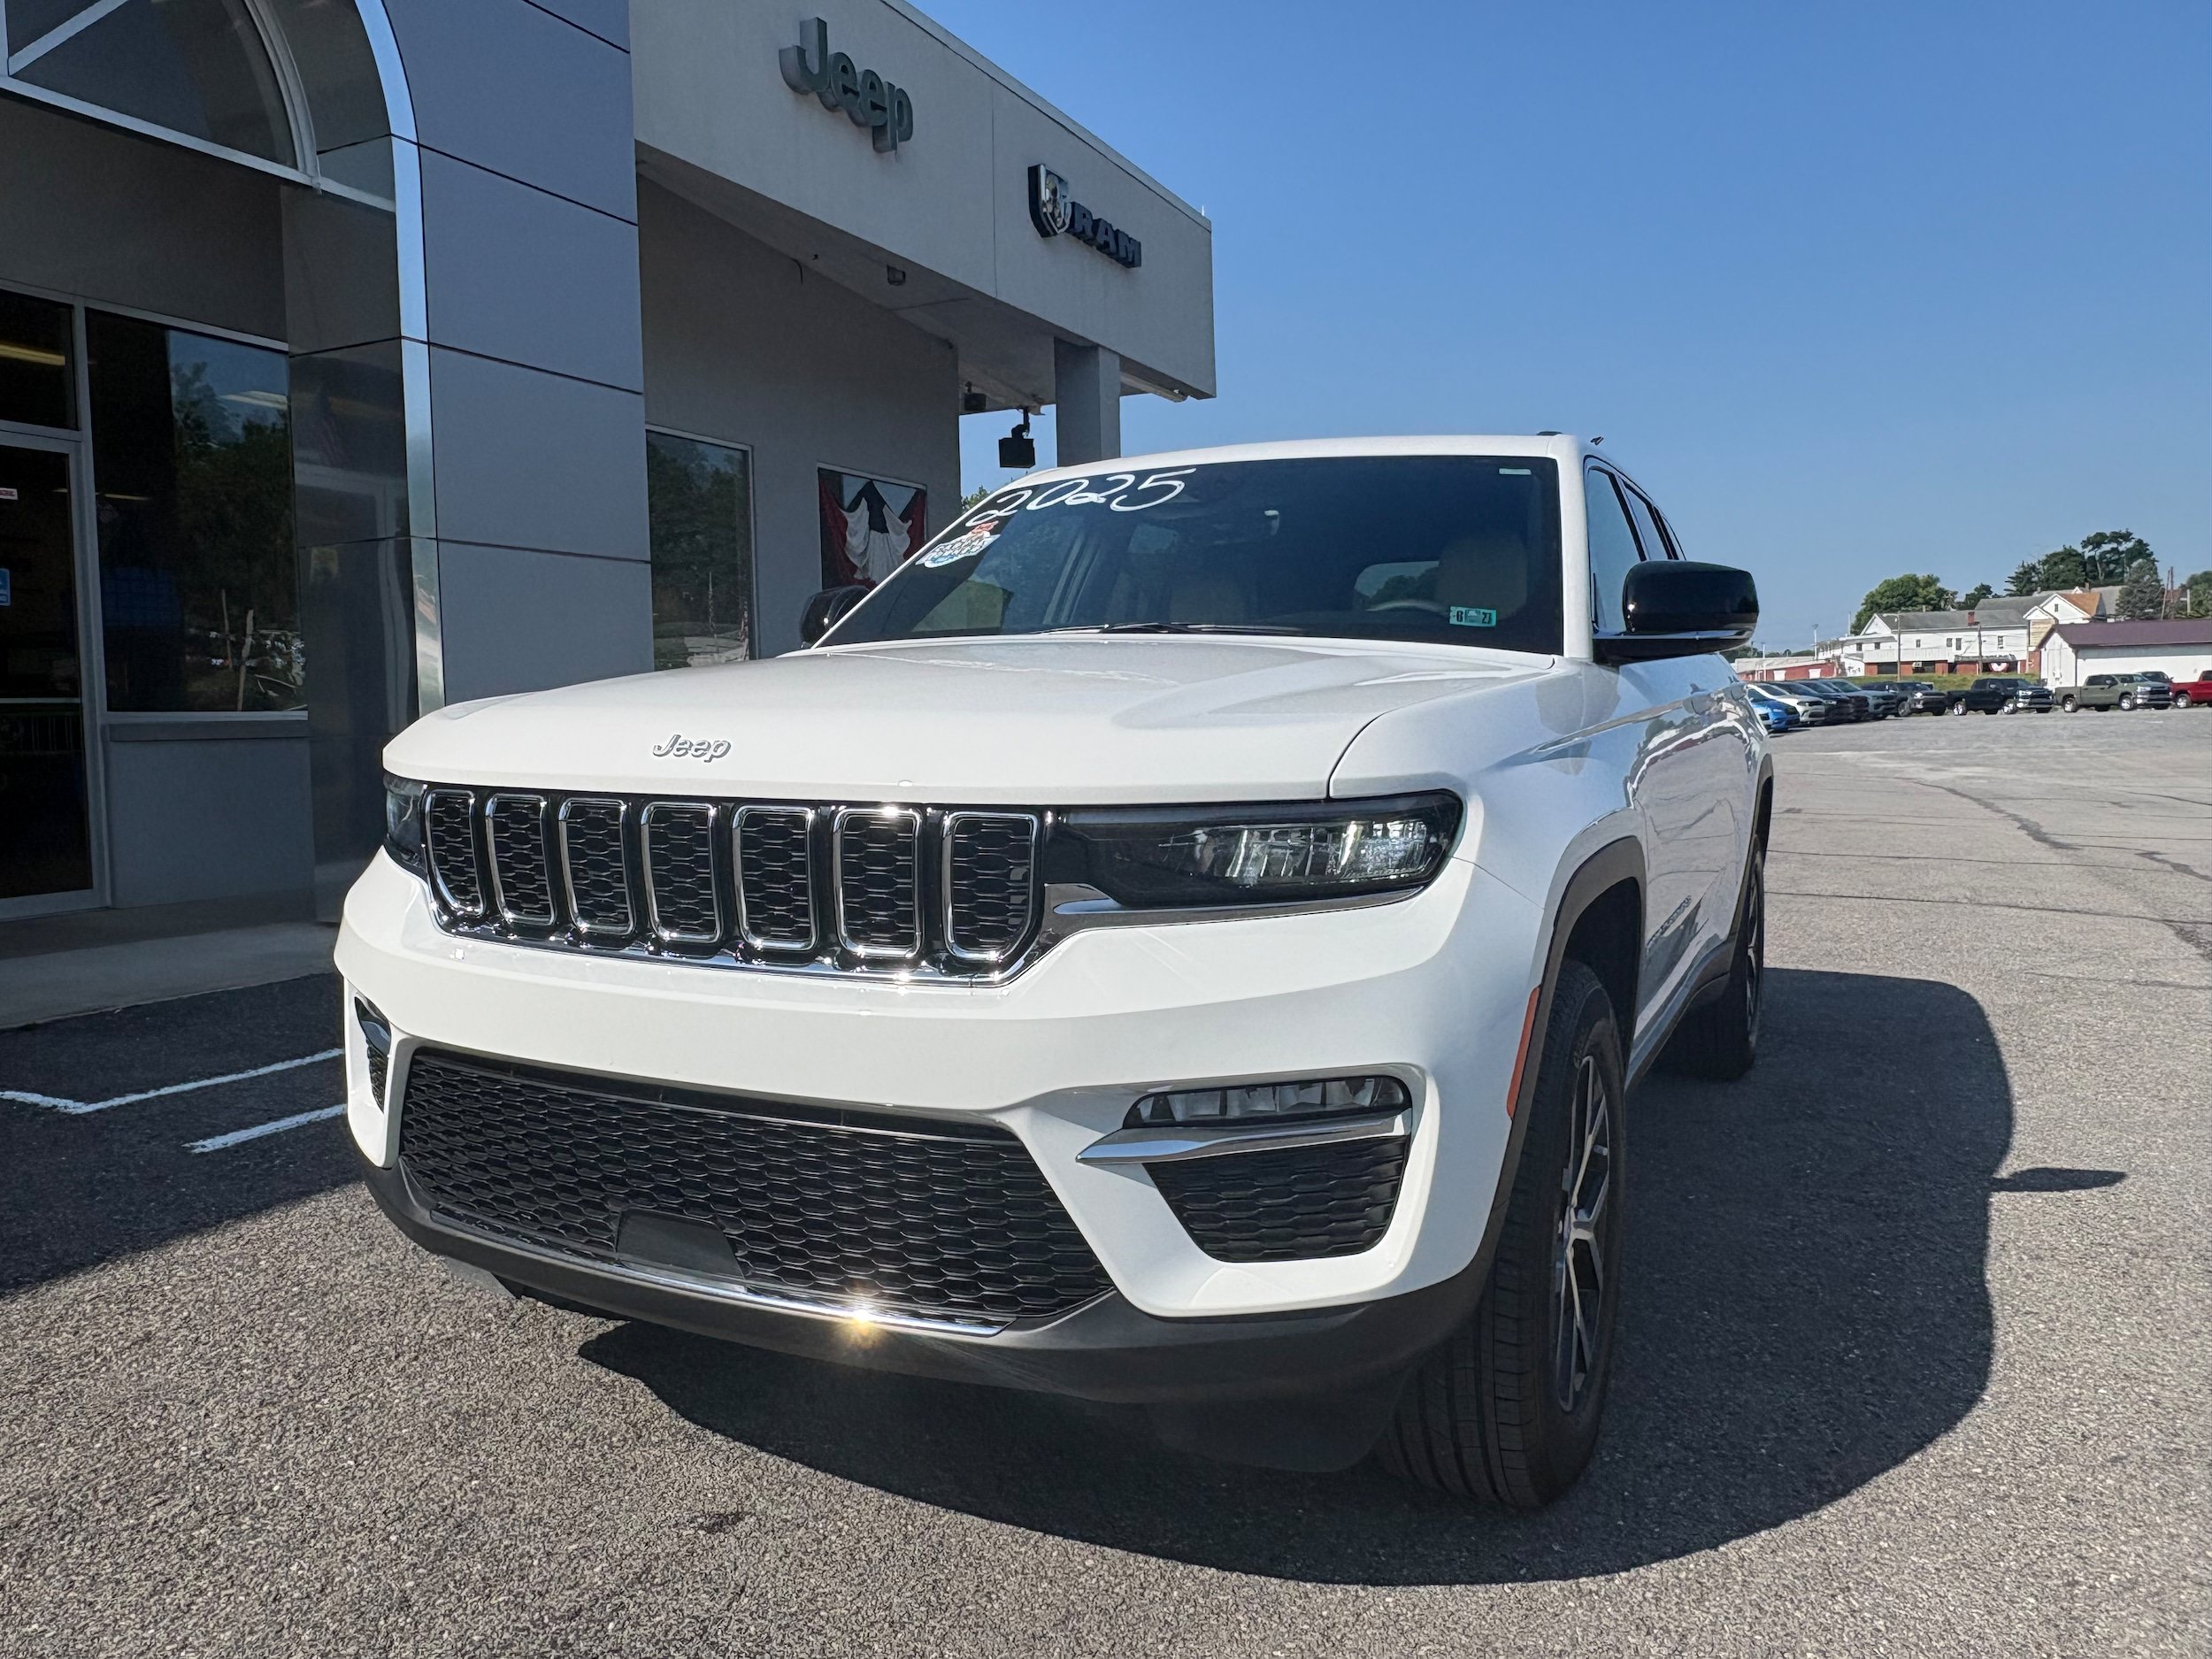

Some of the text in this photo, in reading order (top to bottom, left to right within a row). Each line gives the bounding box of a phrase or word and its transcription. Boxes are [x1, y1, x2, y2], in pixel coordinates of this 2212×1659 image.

[779, 17, 913, 153] Jeep
[1068, 202, 1141, 268] RAM
[965, 468, 1197, 527] 2025
[653, 733, 732, 764] Jeep
